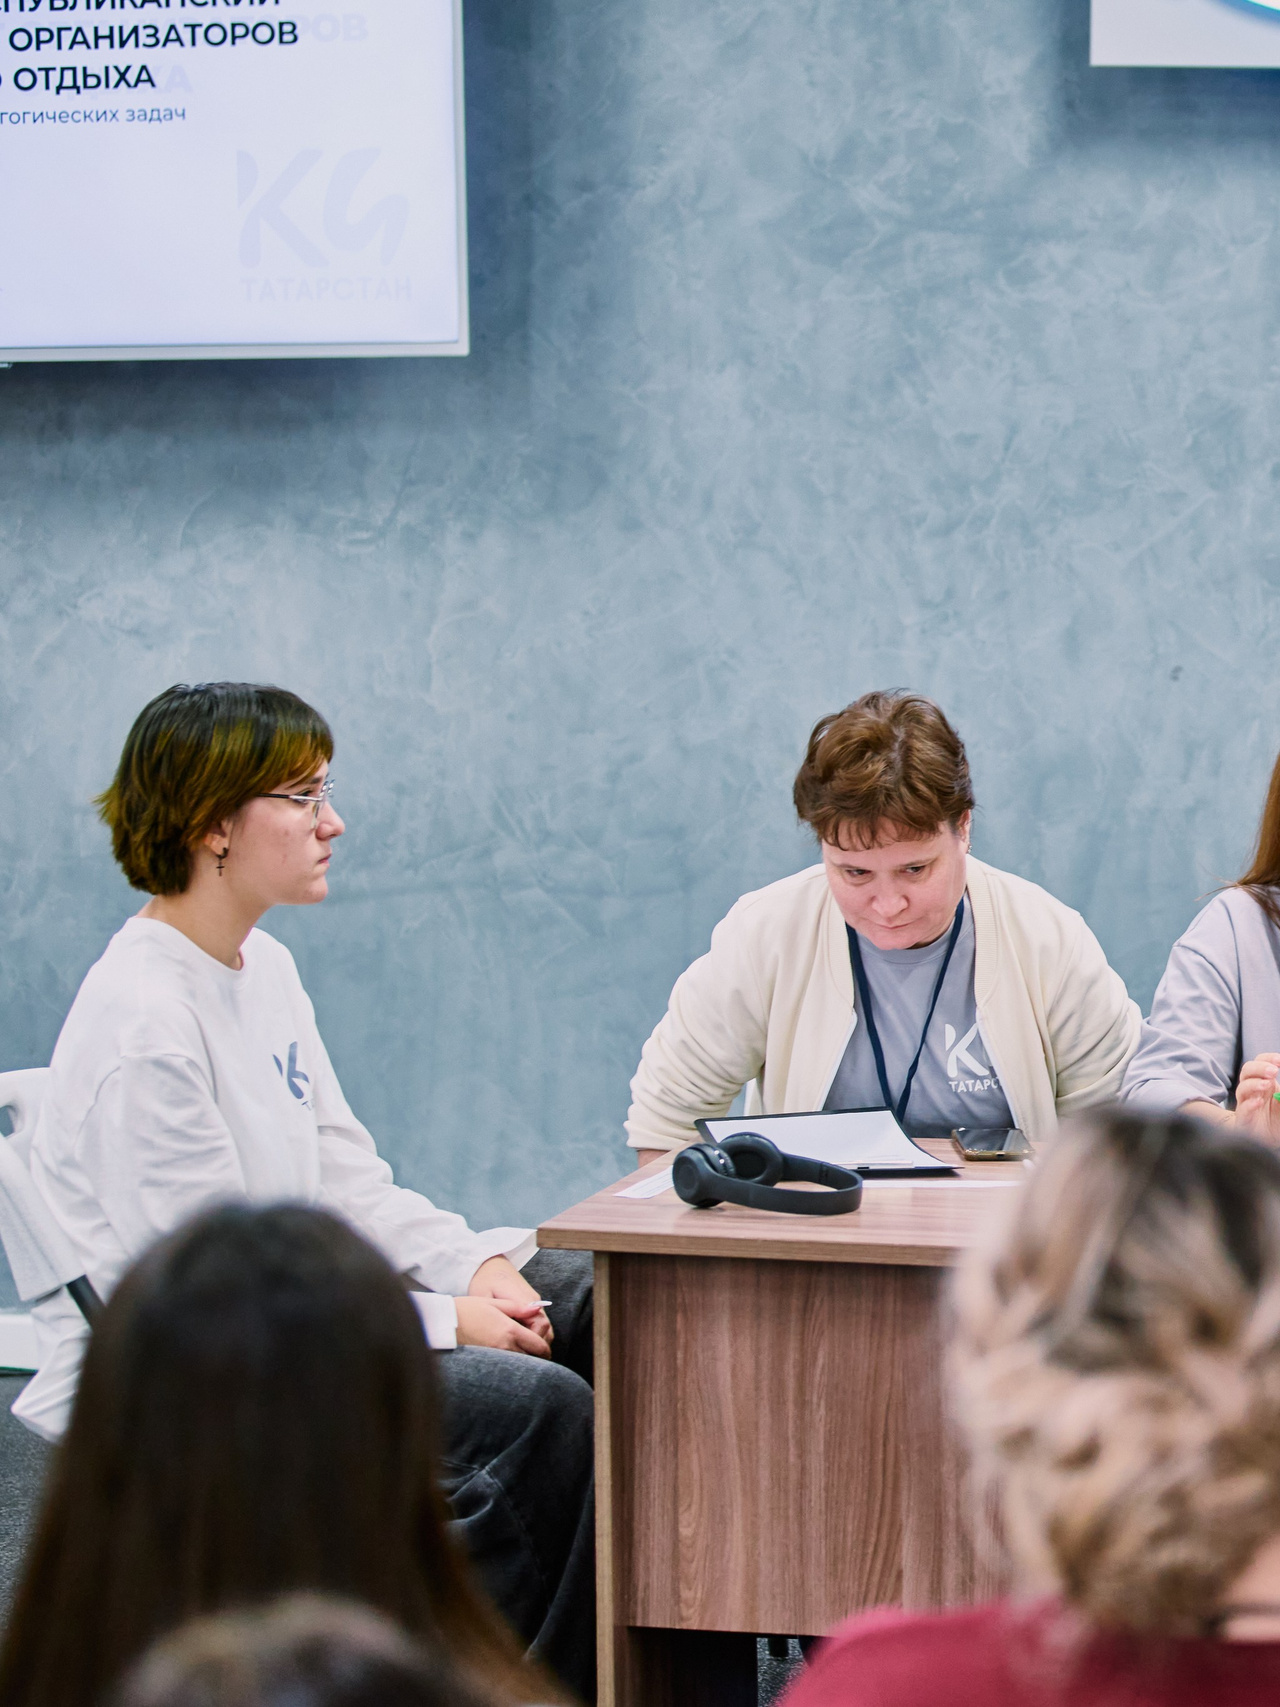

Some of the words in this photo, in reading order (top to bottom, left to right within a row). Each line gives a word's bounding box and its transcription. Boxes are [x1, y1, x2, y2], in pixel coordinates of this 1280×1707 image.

[9, 22, 299, 52] ОРГАНИЗАТОРОВ
[13, 64, 156, 95] ОТДЫХА
[125, 107, 187, 123] задач
[239, 275, 412, 303] ТАТАРСТАН
